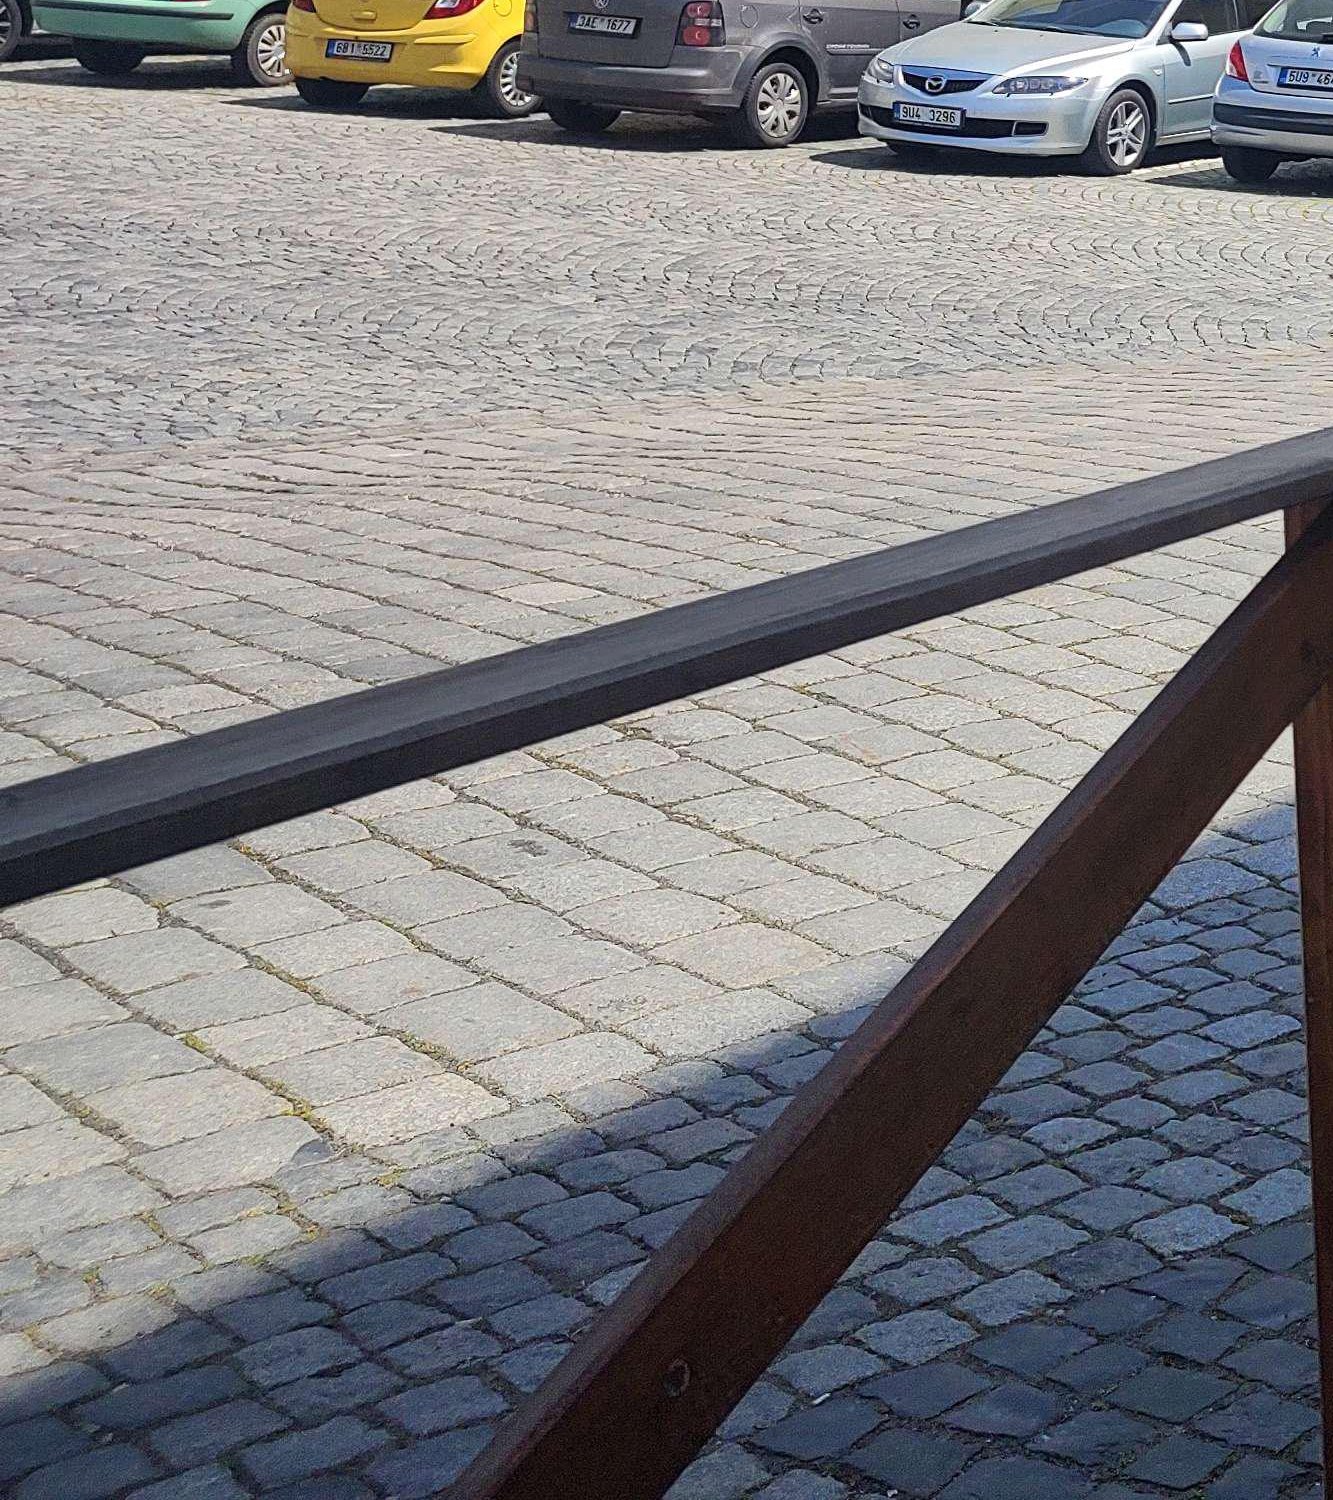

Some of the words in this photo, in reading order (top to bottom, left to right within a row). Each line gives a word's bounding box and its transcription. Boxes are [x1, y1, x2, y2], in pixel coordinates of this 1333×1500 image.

[606, 19, 633, 32] 1677
[362, 43, 387, 57] 5522
[902, 106, 921, 120] 9U4
[929, 109, 956, 124] 3296
